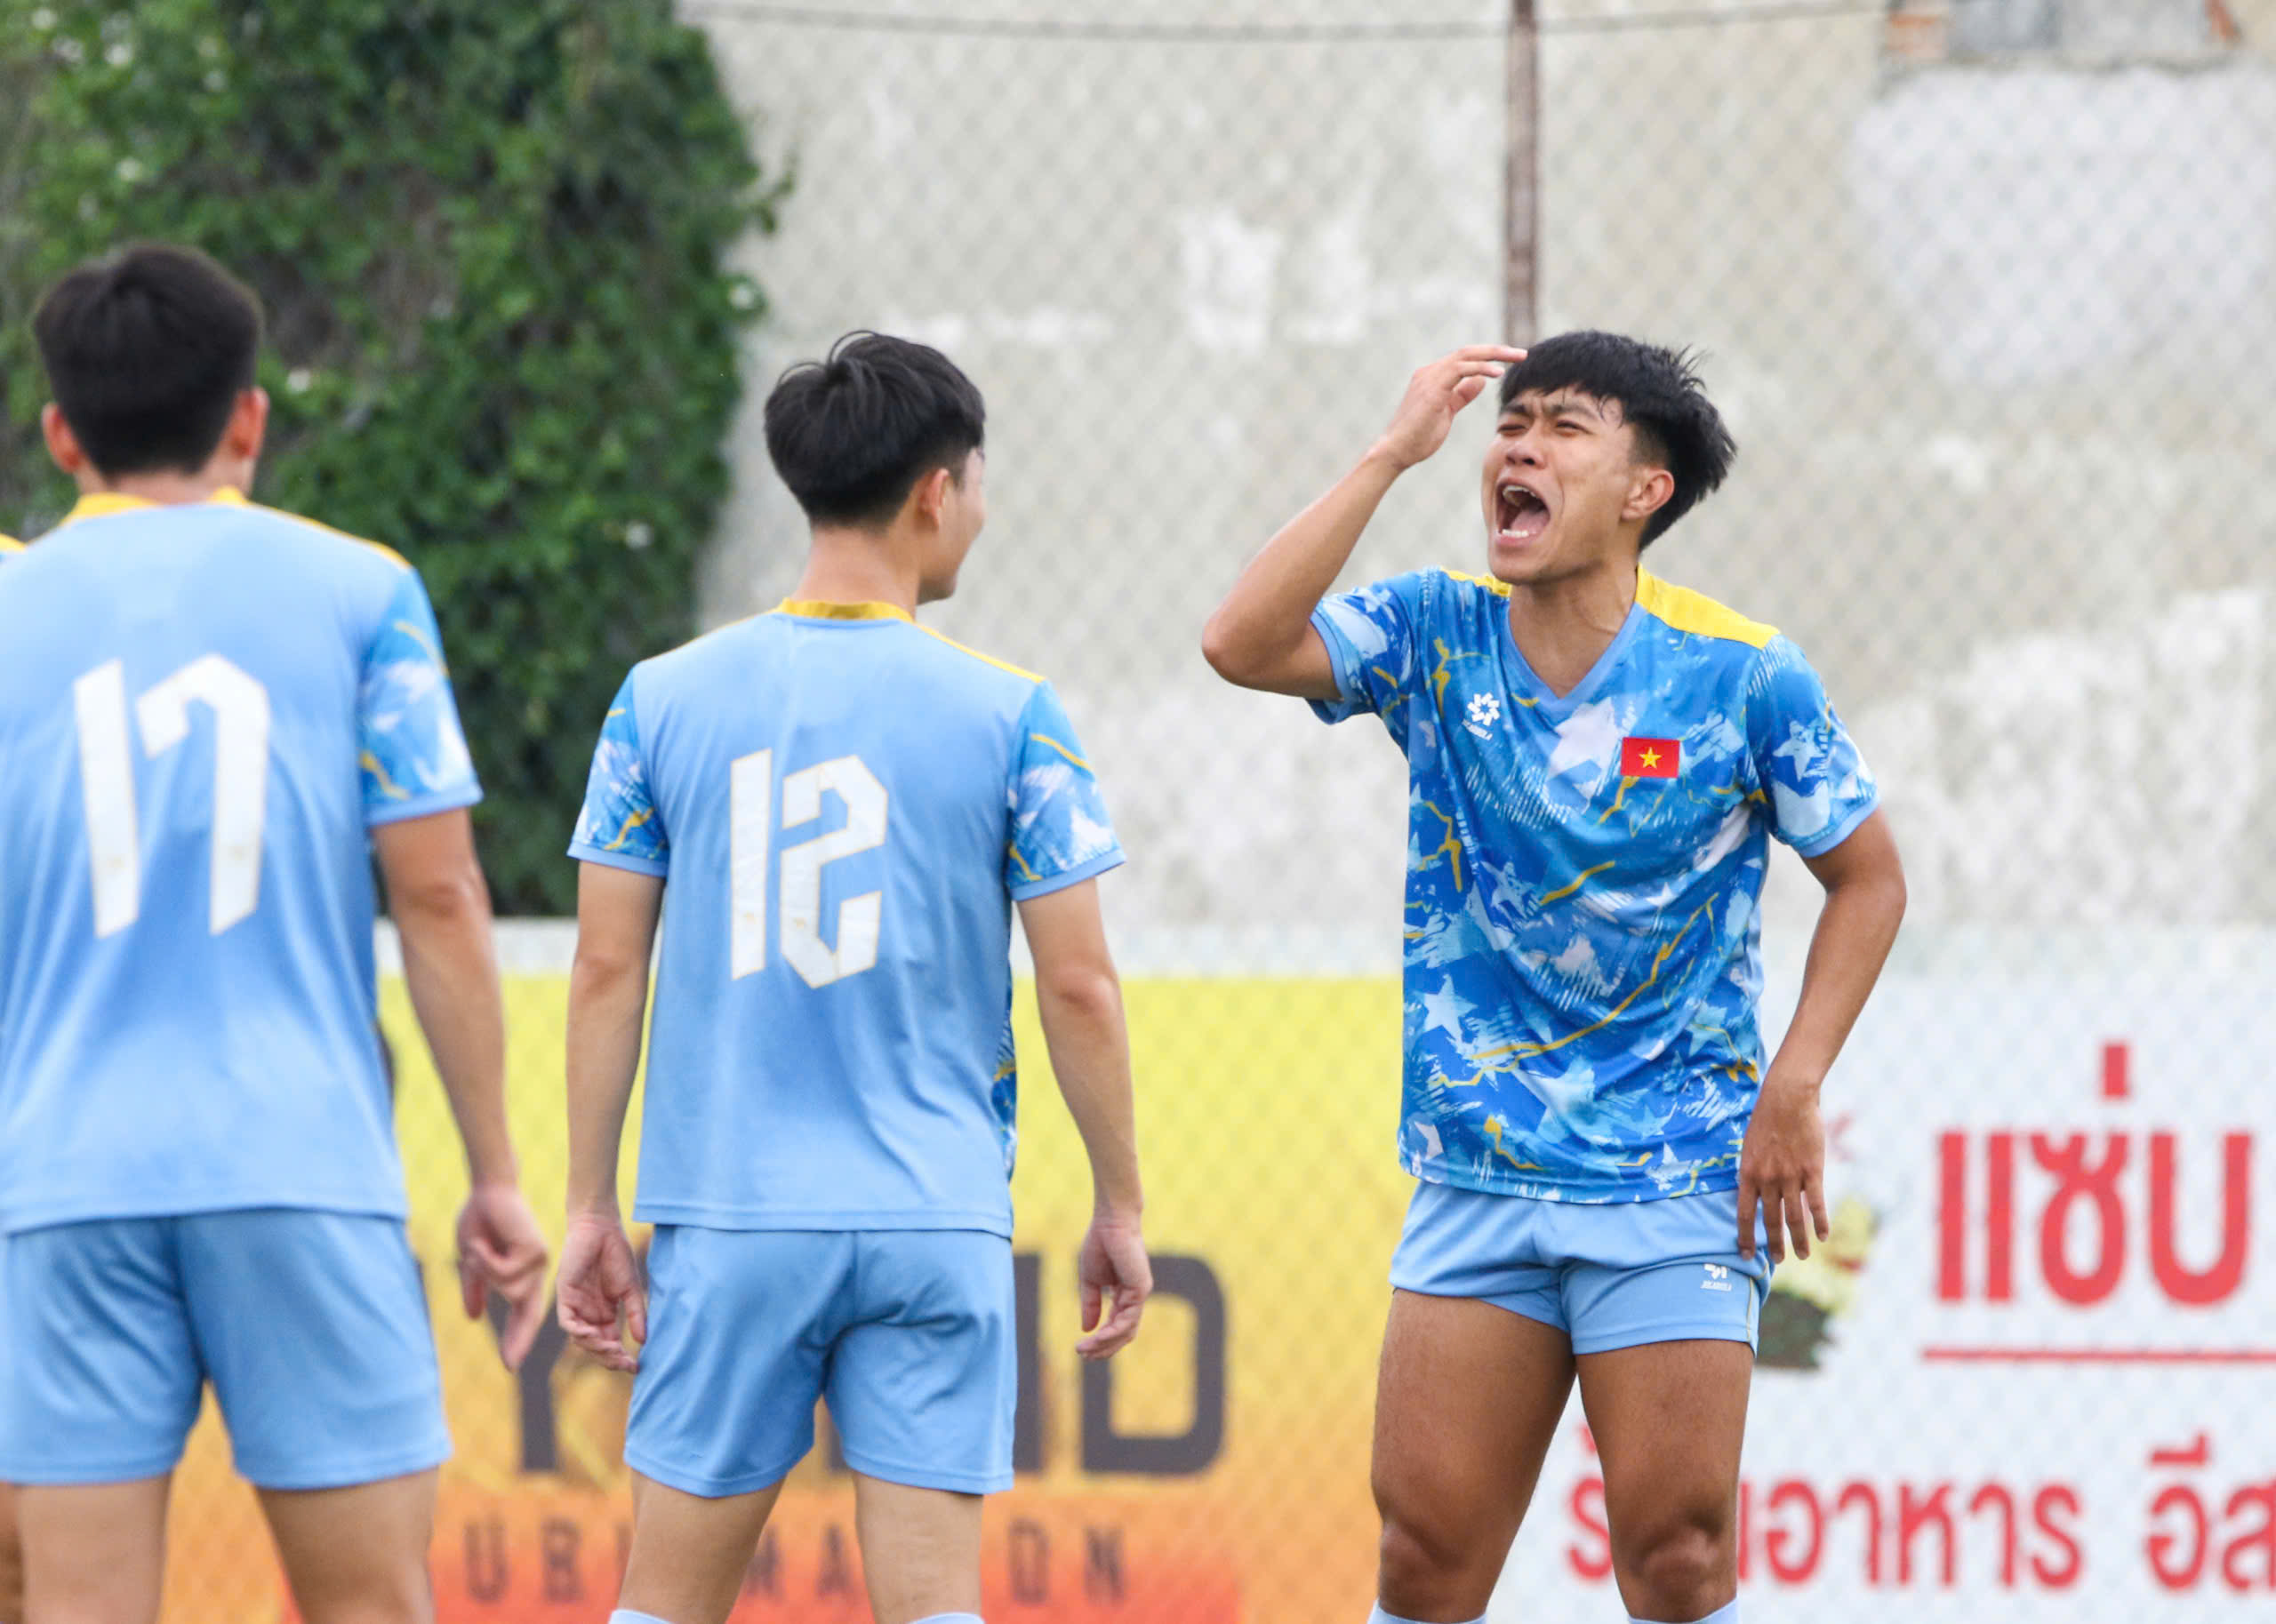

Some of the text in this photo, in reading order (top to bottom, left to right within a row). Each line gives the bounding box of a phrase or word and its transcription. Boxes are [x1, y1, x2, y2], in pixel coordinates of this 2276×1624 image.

[74, 651, 270, 940] 17
[730, 746, 889, 990] 12
[1938, 1043, 2253, 1308] แซ่บ
